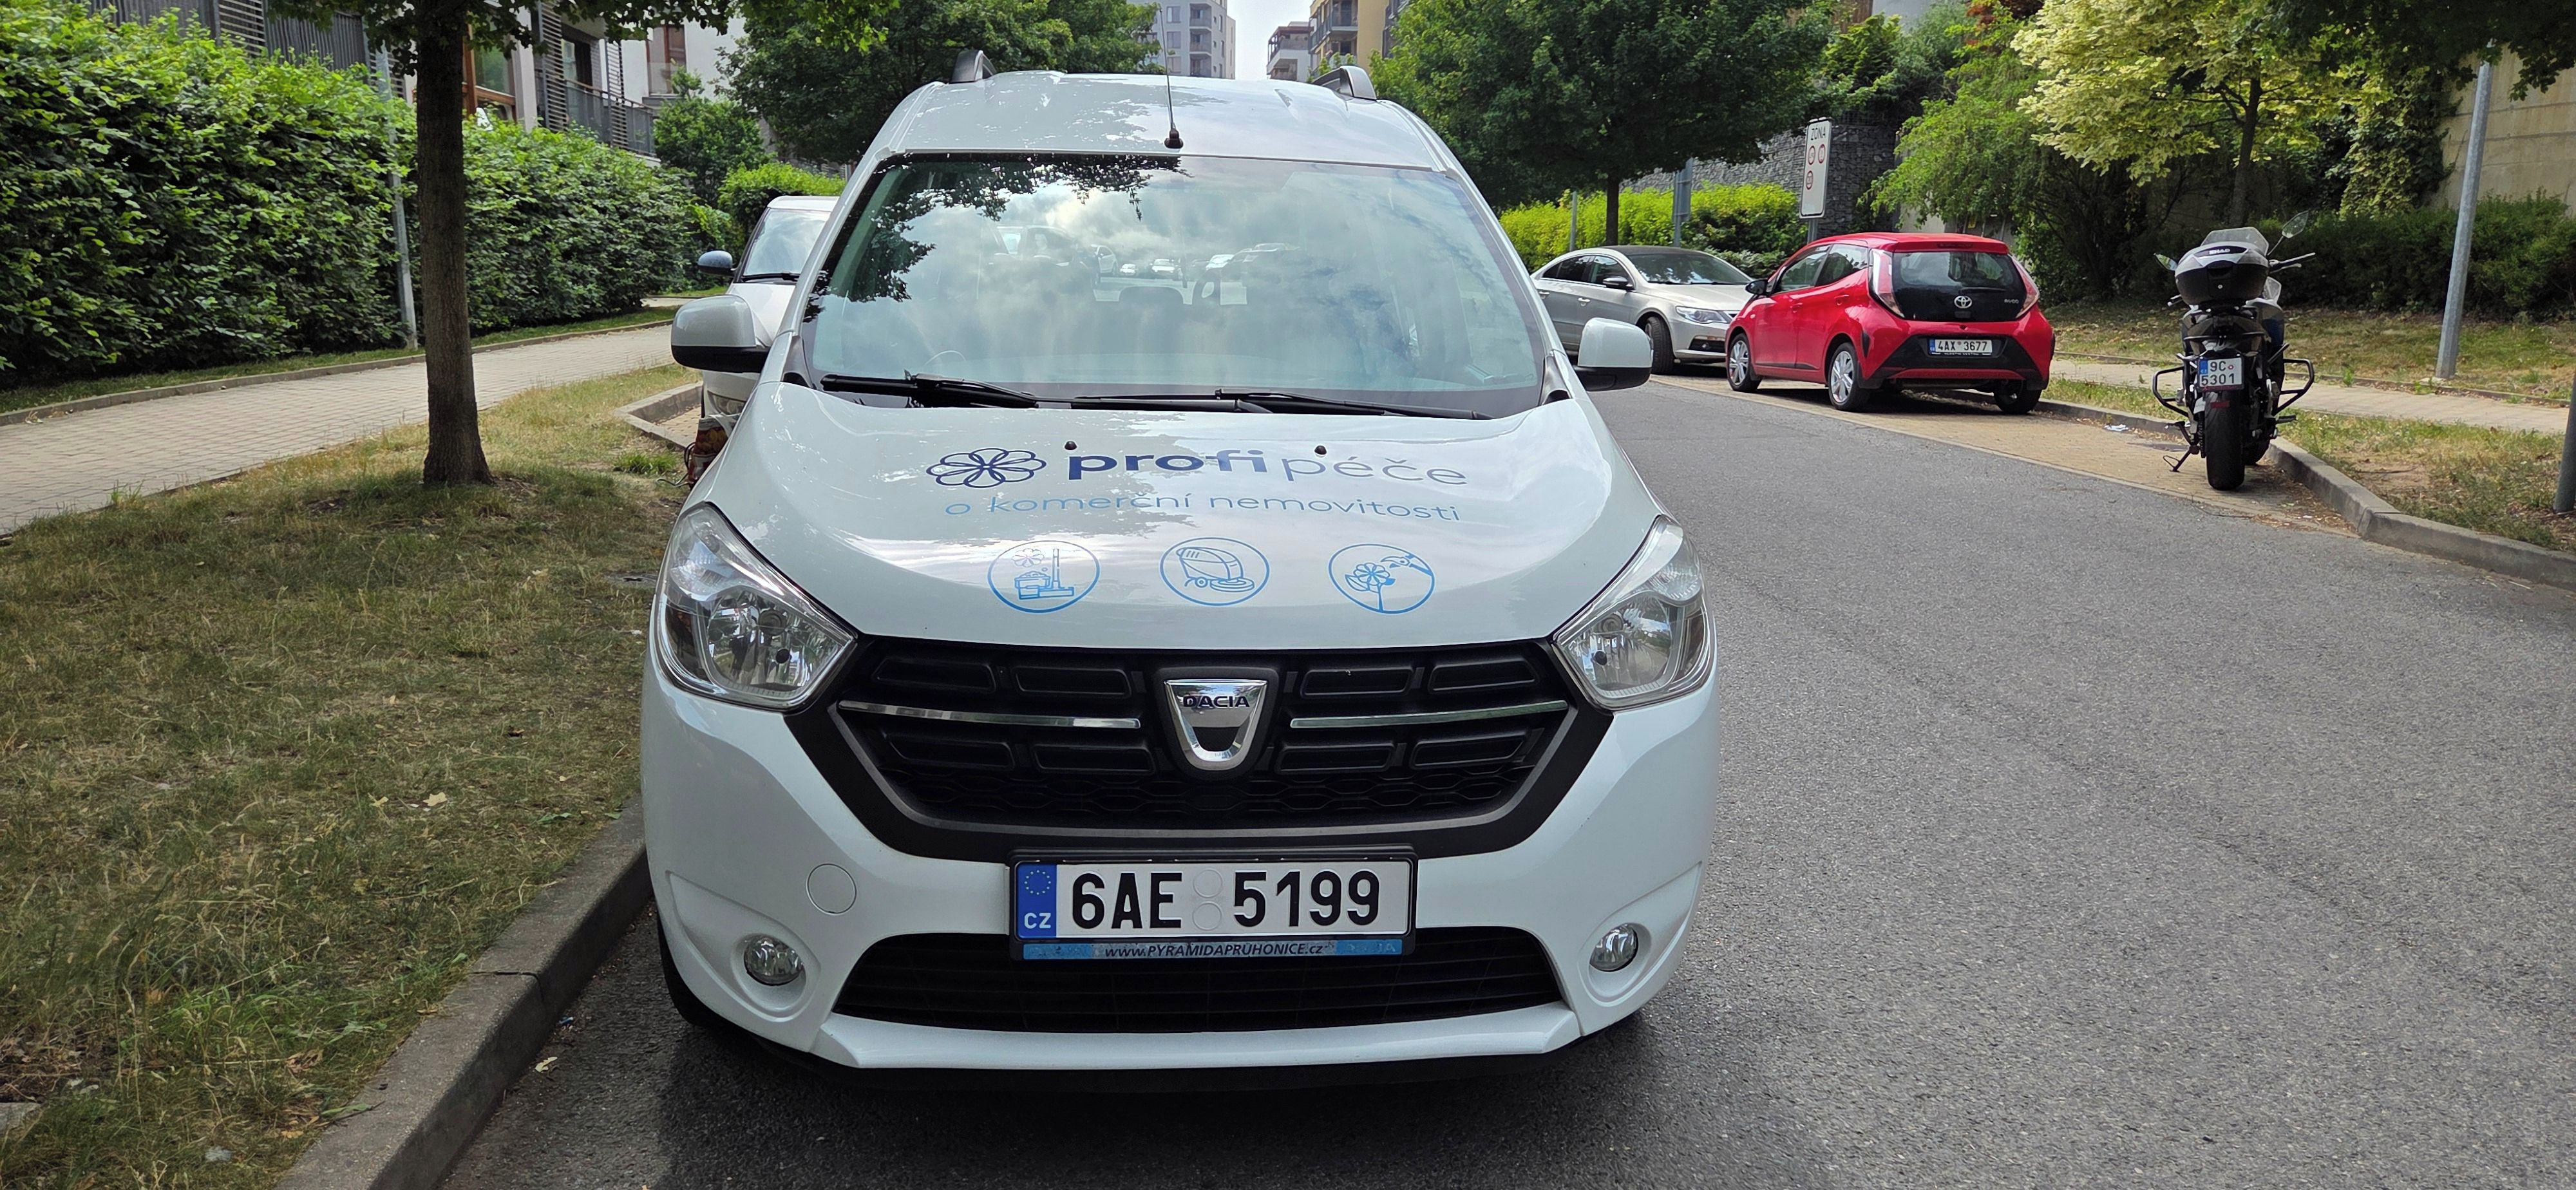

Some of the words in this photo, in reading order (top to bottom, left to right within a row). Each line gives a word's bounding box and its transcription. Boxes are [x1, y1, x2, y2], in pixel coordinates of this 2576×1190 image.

[1938, 341, 1956, 351] 4AX
[1964, 341, 1987, 351] 3677
[2210, 361, 2226, 372] 9C
[2201, 373, 2235, 386] 5301
[945, 504, 971, 515] o
[990, 493, 1191, 513] komerční
[1209, 497, 1459, 521] nemovitosti
[1183, 695, 1250, 708] DACIA
[1072, 872, 1182, 929] 6AE
[1233, 871, 1379, 927] 5199
[1024, 912, 1052, 929] CZ
